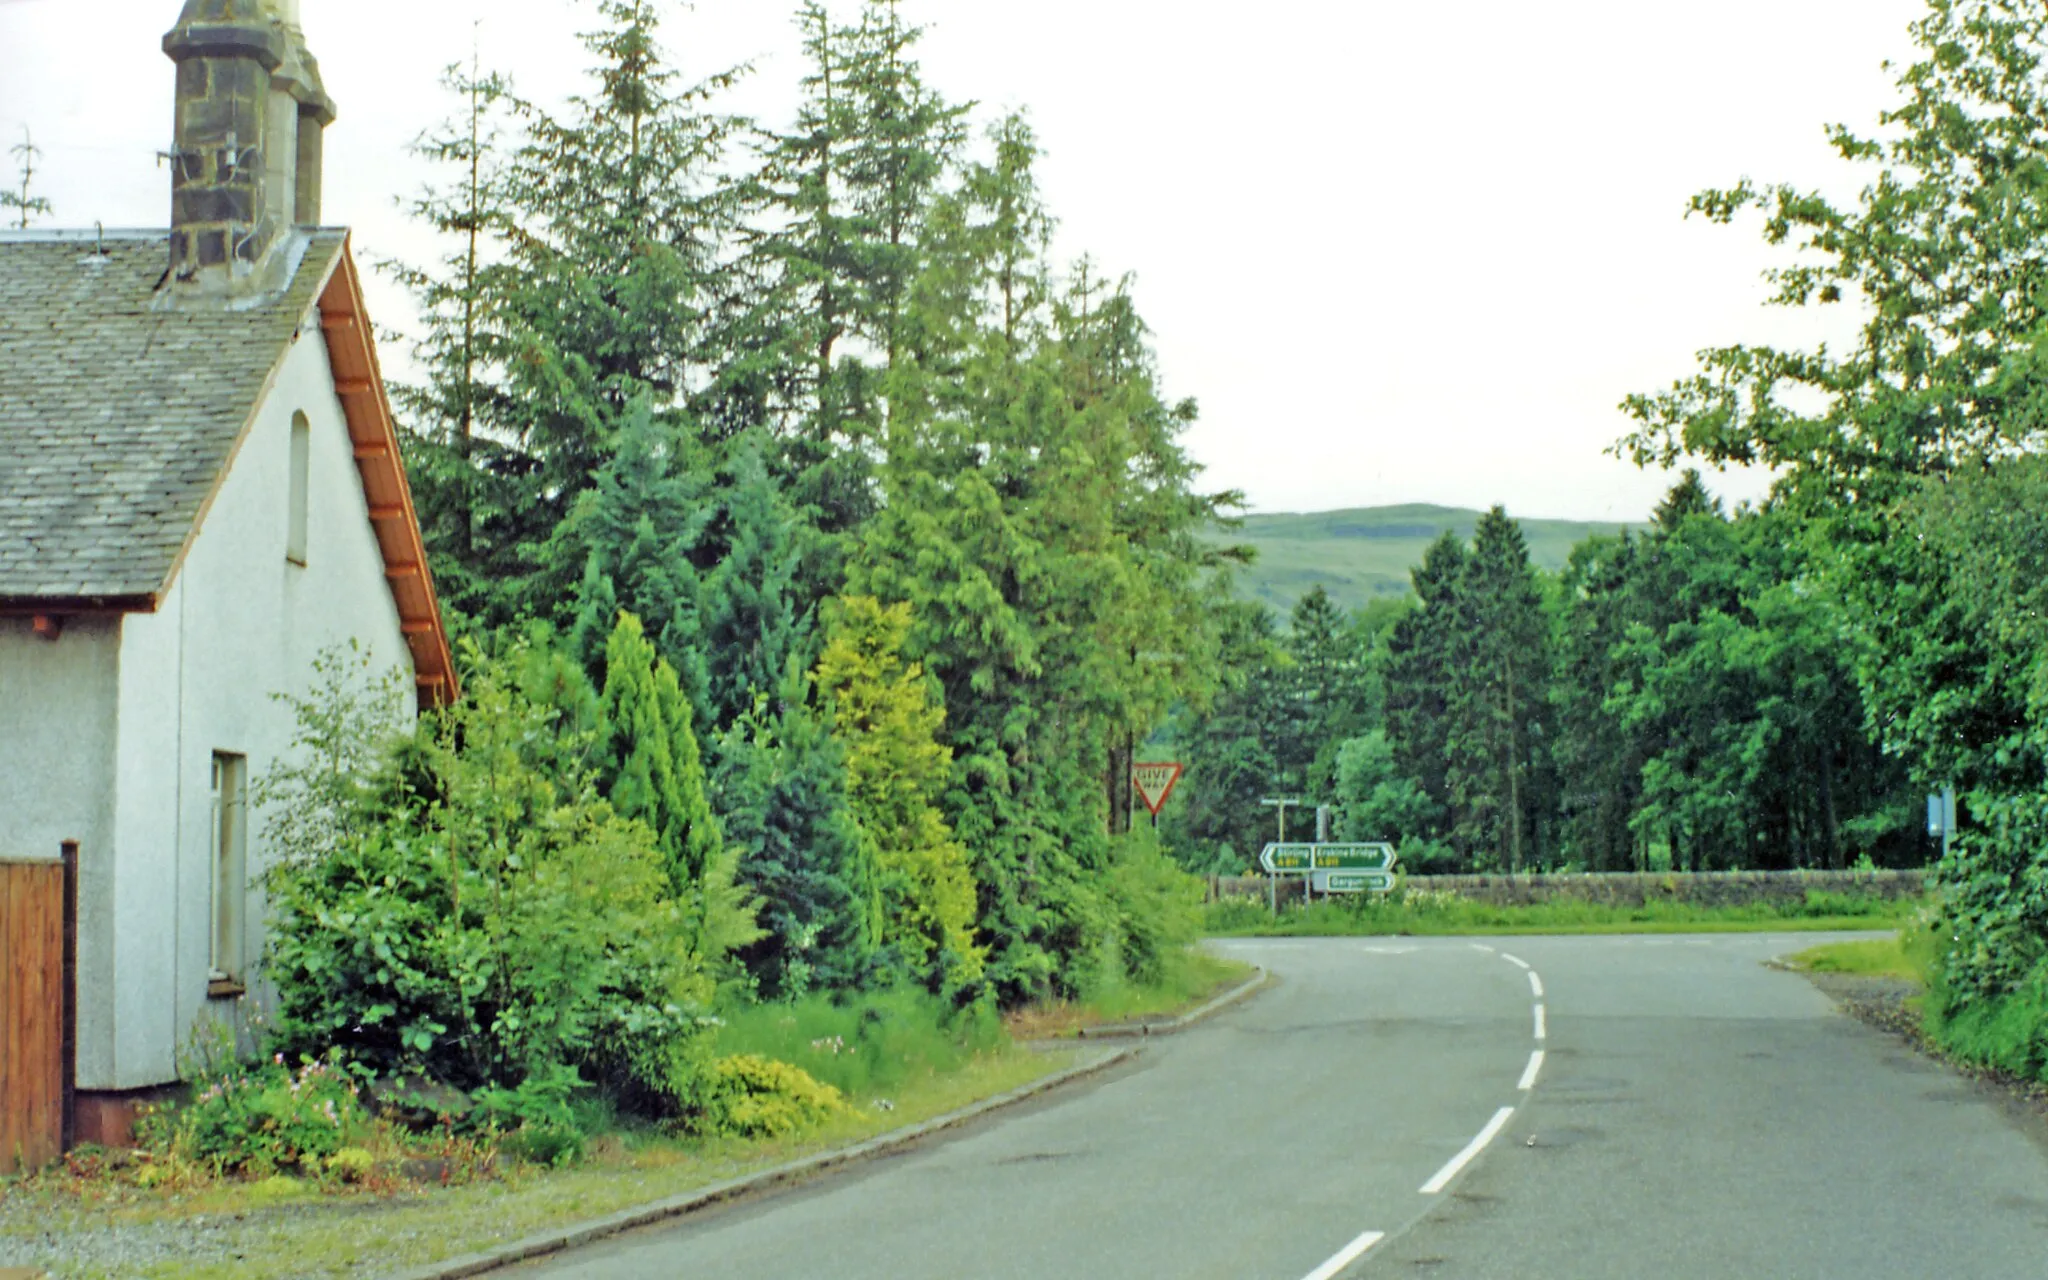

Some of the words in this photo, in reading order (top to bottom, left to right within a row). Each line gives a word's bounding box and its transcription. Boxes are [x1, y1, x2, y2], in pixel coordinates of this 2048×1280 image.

[1136, 769, 1168, 779] GIVE
[1143, 780, 1165, 789] WAY
[1350, 847, 1379, 860] Bridge
